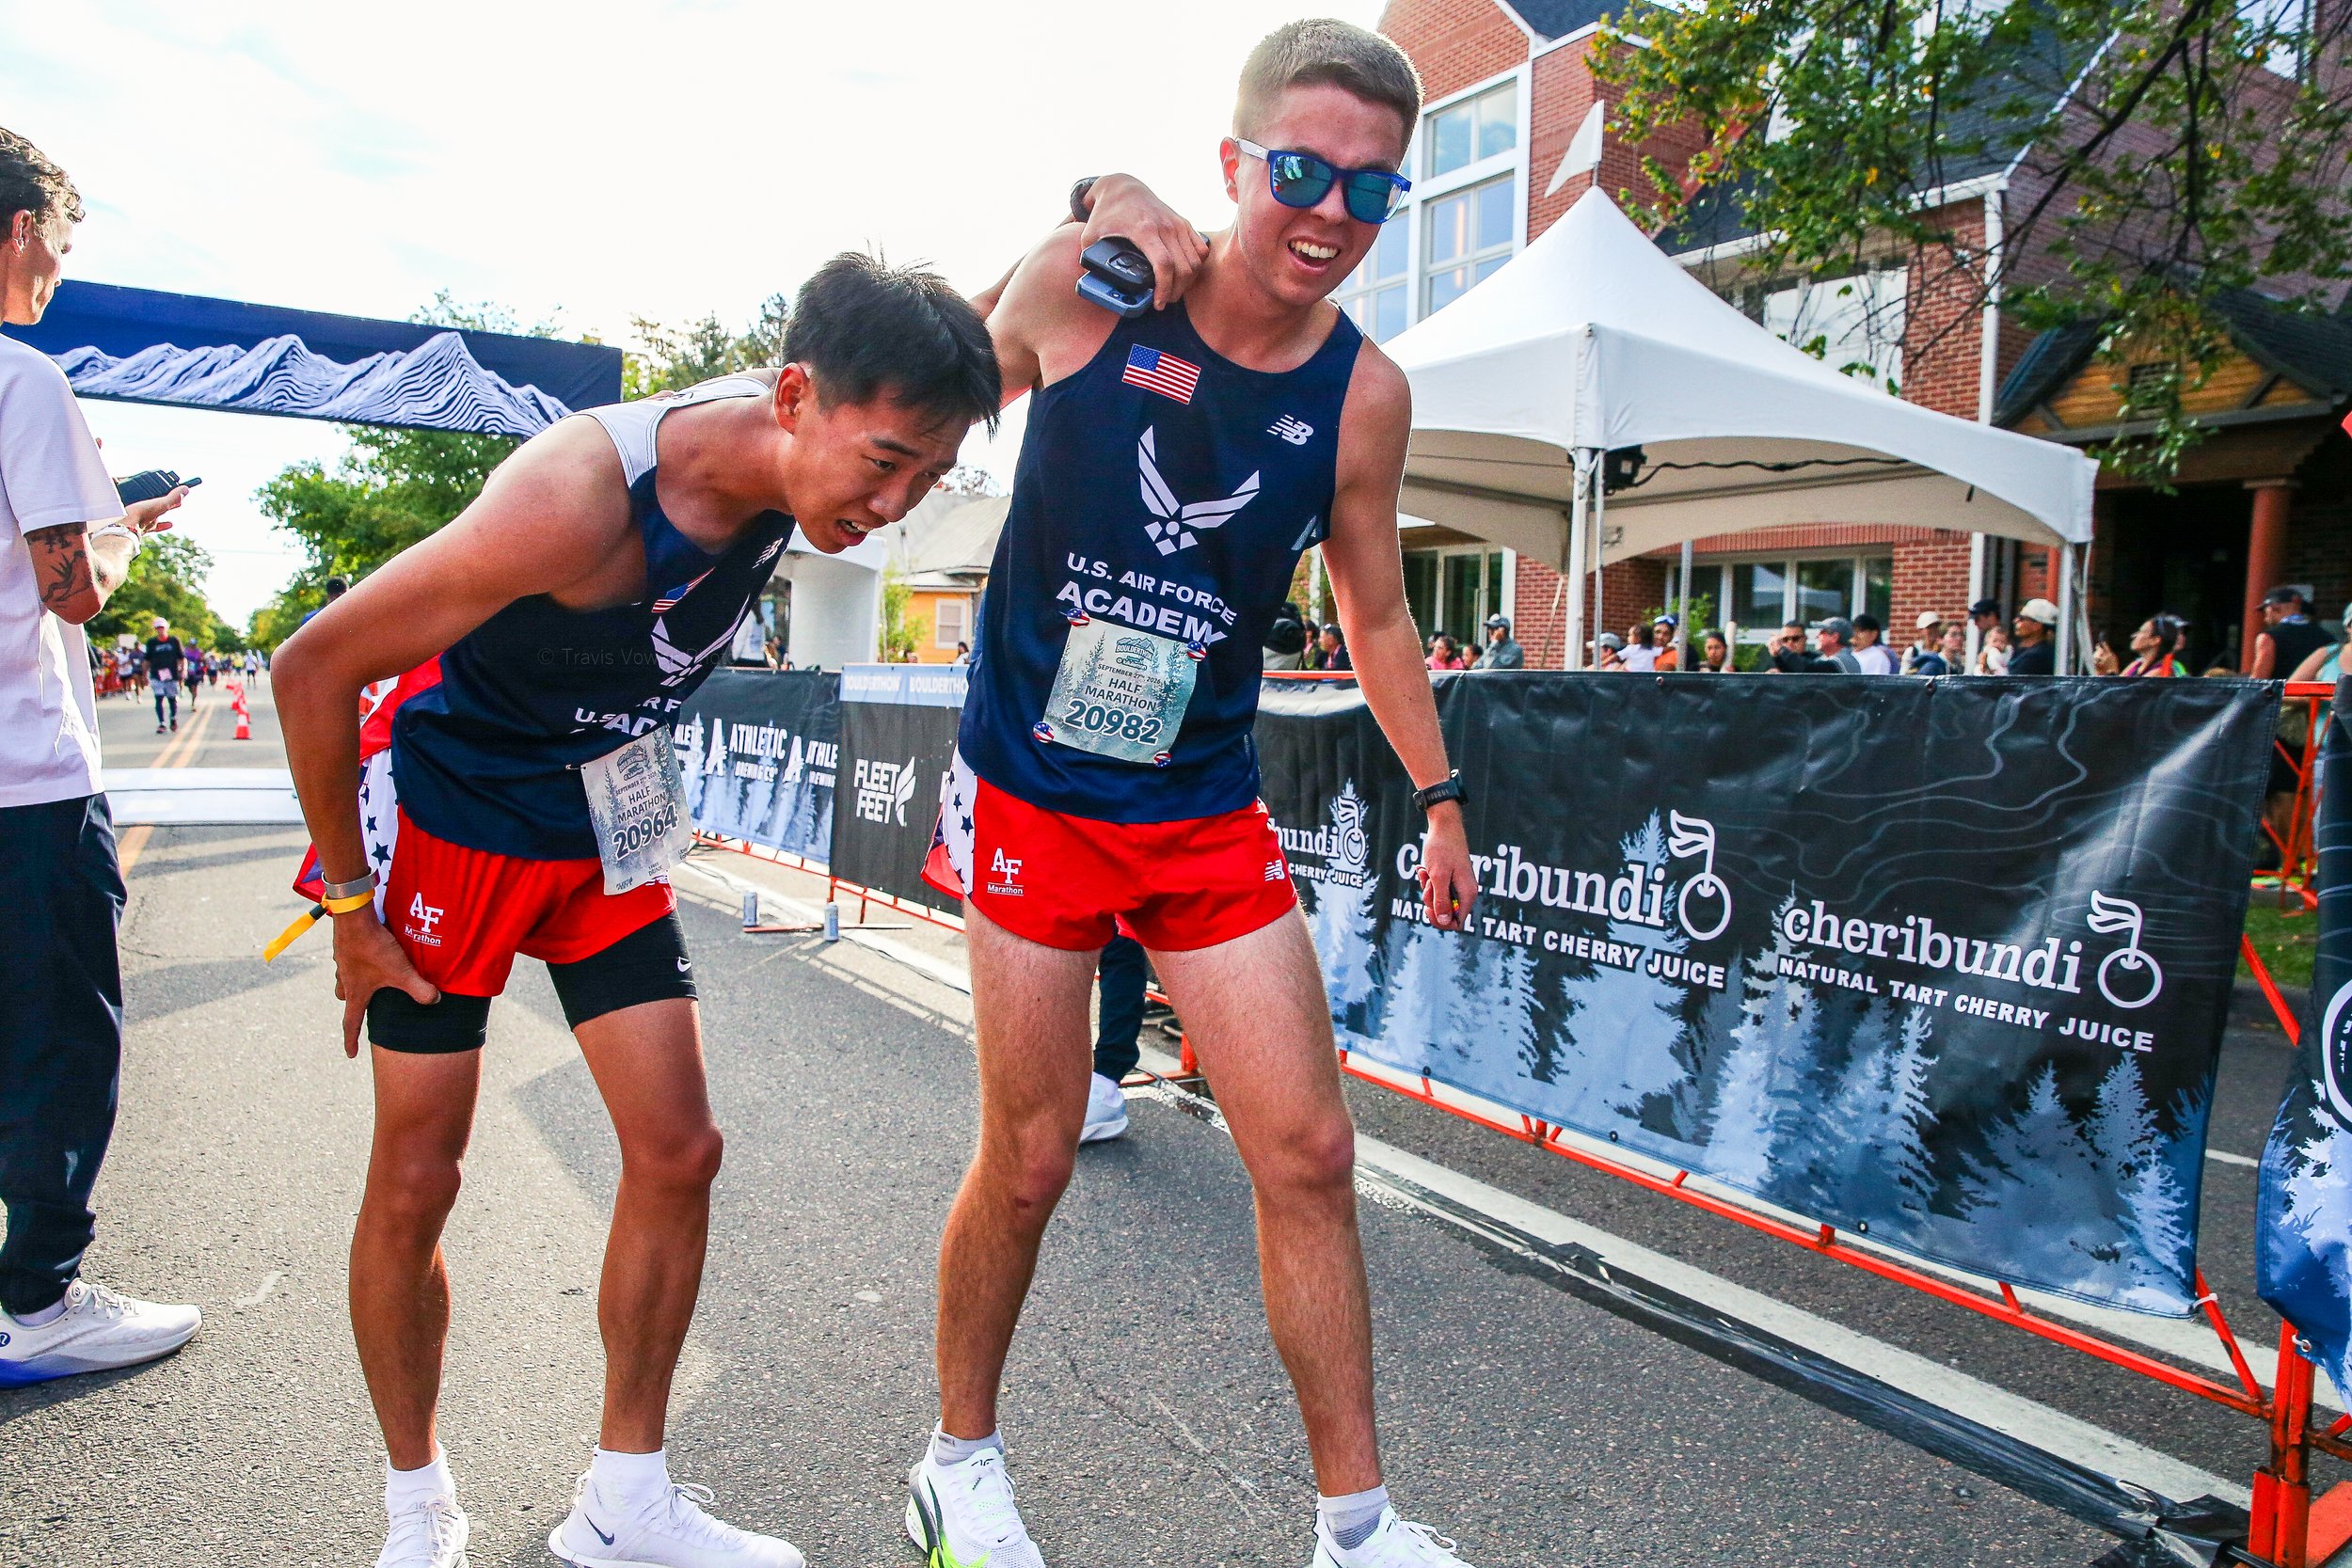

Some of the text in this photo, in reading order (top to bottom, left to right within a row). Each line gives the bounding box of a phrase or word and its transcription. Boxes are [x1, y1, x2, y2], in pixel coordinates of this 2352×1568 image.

[1067, 552, 1237, 626] U.S. AIR FORCE
[1056, 580, 1227, 646] ACADEMY
[909, 675, 968, 694] BOULDERTHO
[1097, 663, 1133, 677] SEPTEMBER
[1108, 677, 1142, 694] HALF
[1085, 685, 1157, 712] MARATHON
[1064, 699, 1162, 746] 20982
[729, 723, 788, 760] ATHLETIC
[853, 758, 901, 795] FLEET
[617, 792, 667, 824] MARATHON
[628, 786, 651, 805] HALF
[855, 788, 895, 825] FEET
[612, 802, 679, 861] 20964
[991, 847, 1022, 884] AF
[1287, 863, 1362, 887] CHERRY JUICE
[1396, 832, 1665, 927] cribundi
[988, 883, 1024, 895] Marathon
[409, 892, 444, 933] AF
[405, 926, 441, 945] Mrathon
[1482, 916, 1536, 945] TART
[1544, 931, 1641, 969] CHERRY
[1646, 952, 1725, 989] JUICE
[1783, 900, 2081, 993] cheribundi
[1779, 958, 2154, 1053] NATURAL TART CHERRY JUICE
